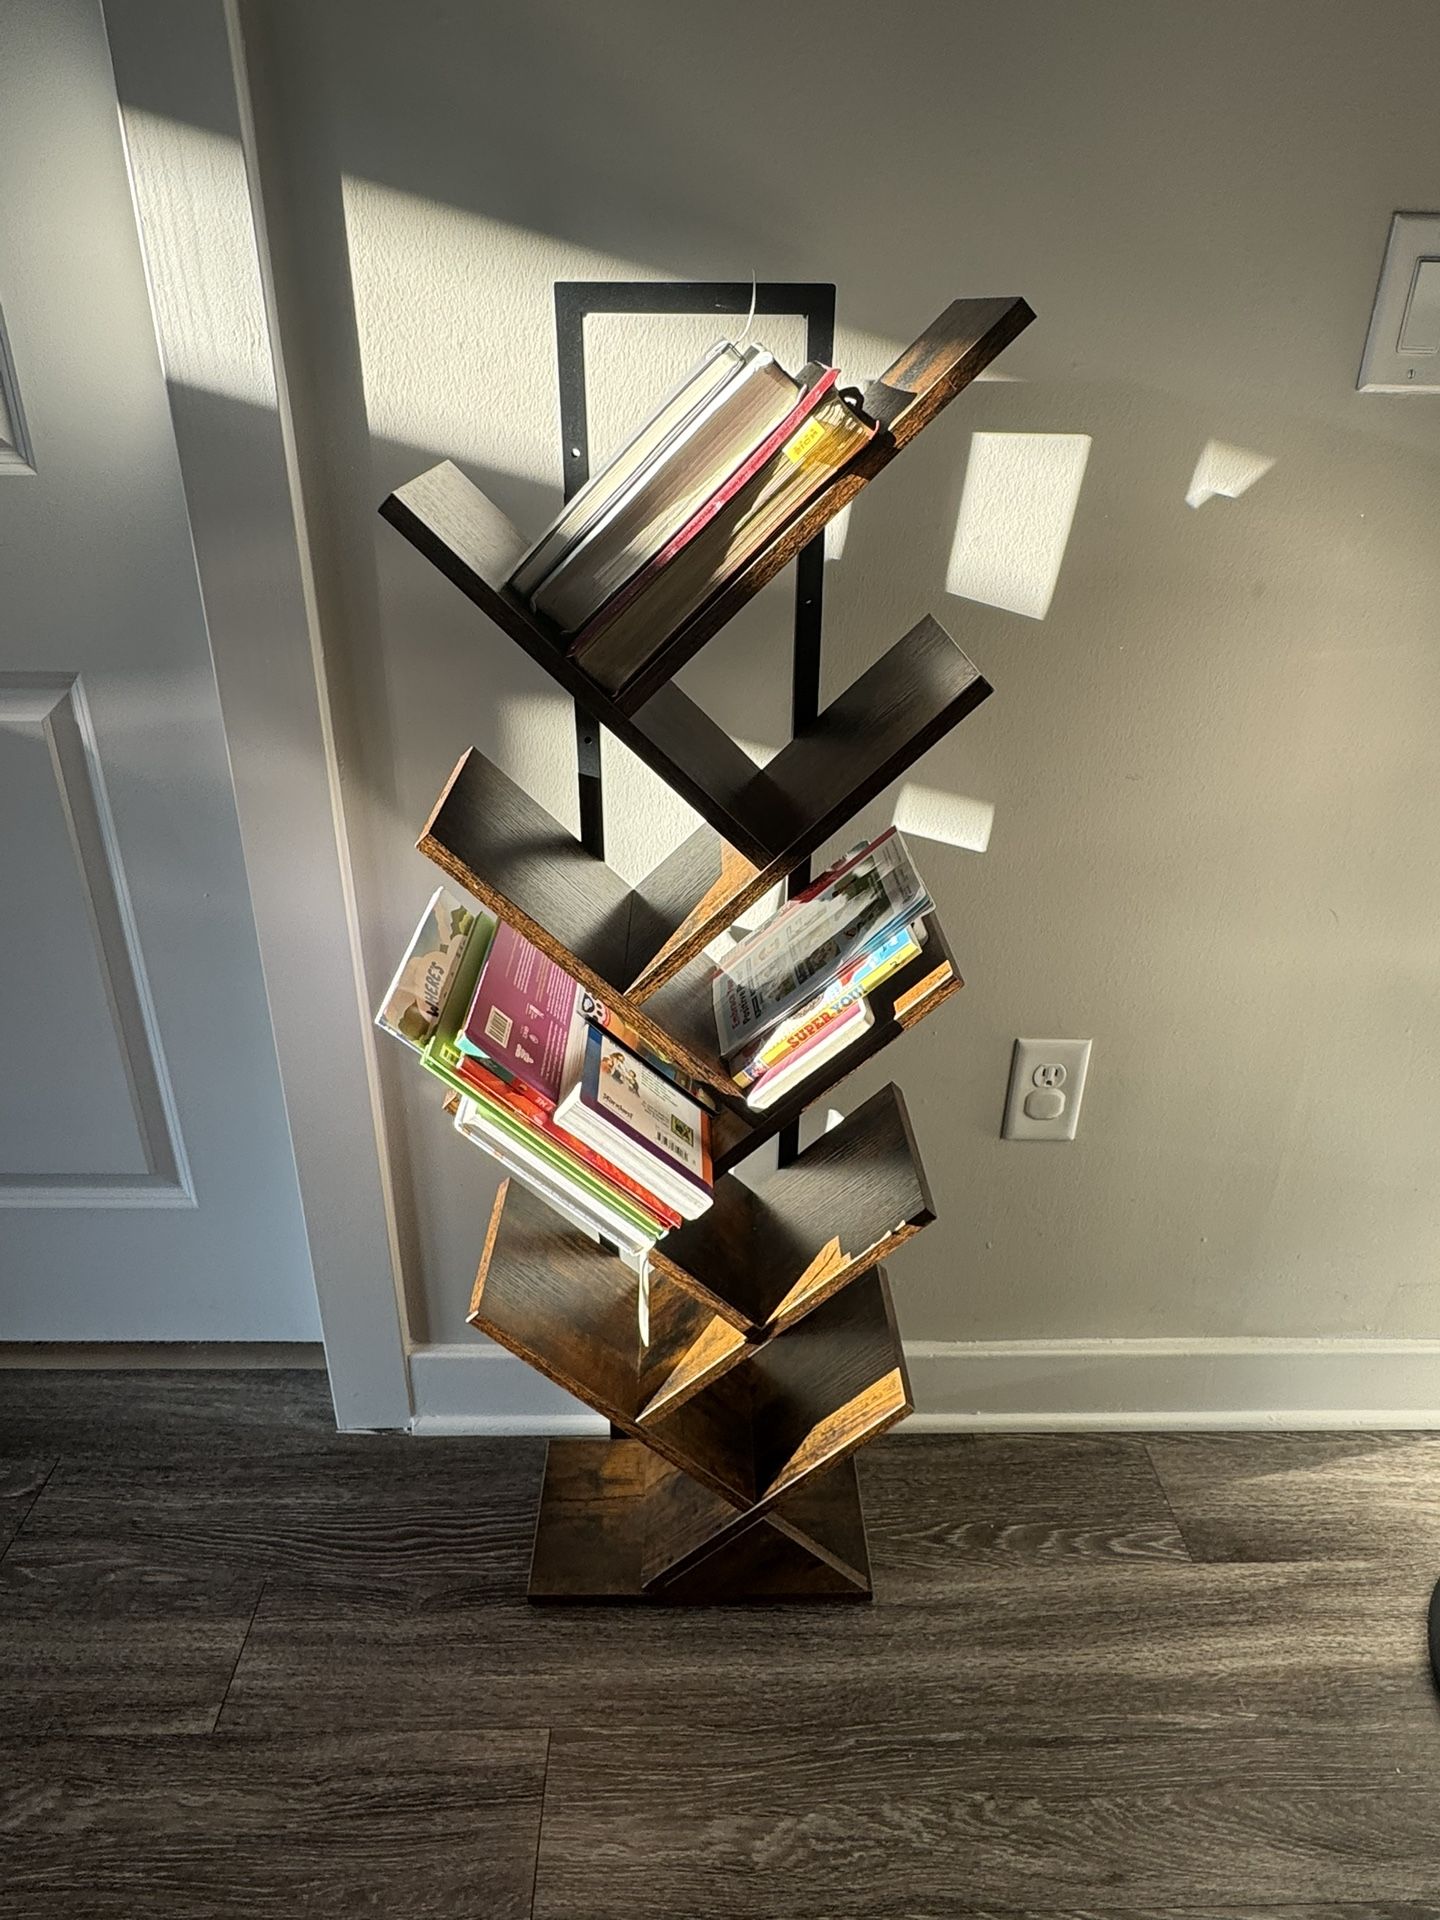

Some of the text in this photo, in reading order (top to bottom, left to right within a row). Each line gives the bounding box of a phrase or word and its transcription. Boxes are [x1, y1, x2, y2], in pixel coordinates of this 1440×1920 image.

[425, 960, 444, 1016] WHERE'S
[785, 983, 867, 1048] SUPER YOU!
